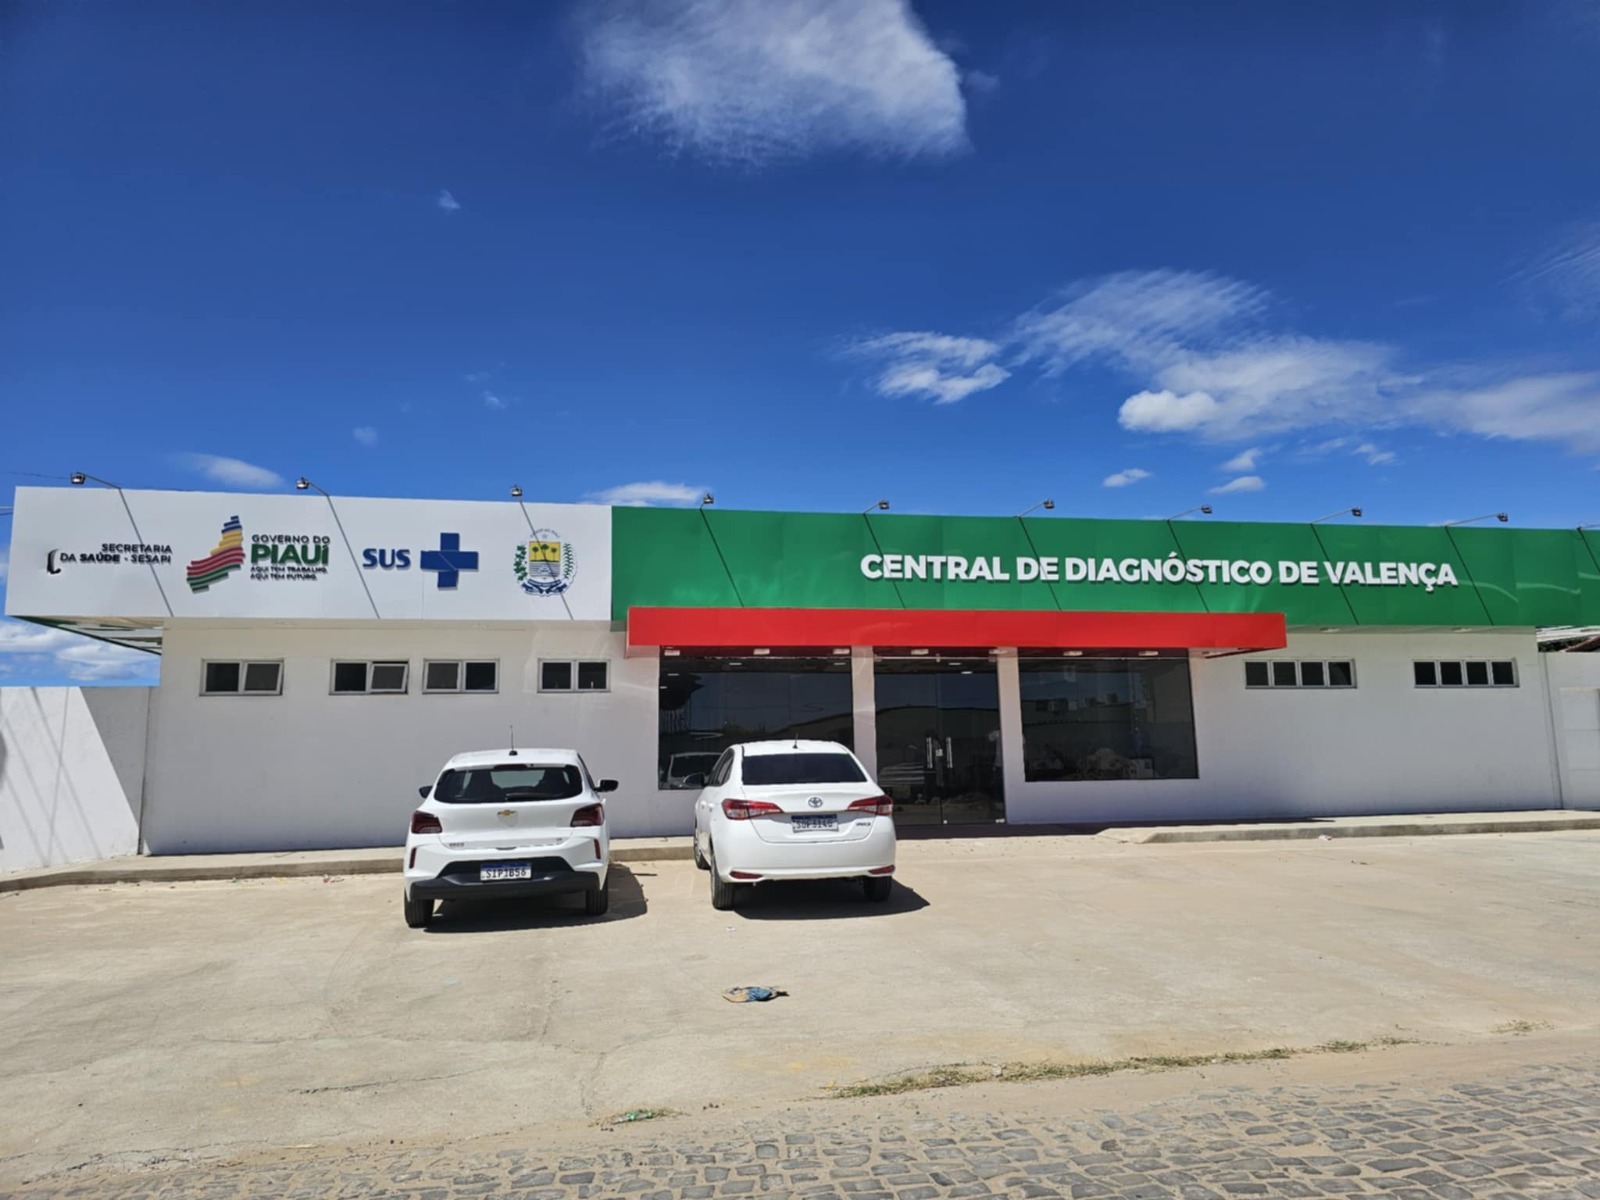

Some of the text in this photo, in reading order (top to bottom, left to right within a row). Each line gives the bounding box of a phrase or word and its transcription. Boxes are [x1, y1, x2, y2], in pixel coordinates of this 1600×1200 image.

[251, 534, 330, 544] GOVERNO DO
[101, 543, 172, 554] SECRETARIA
[60, 552, 77, 562] DA
[80, 551, 121, 563] SAÚDE
[131, 554, 172, 564] SESAPI
[362, 548, 411, 569] SUS
[860, 551, 1459, 591] CENTRAL DE DIAGNÓSTICO DE VALENÇA
